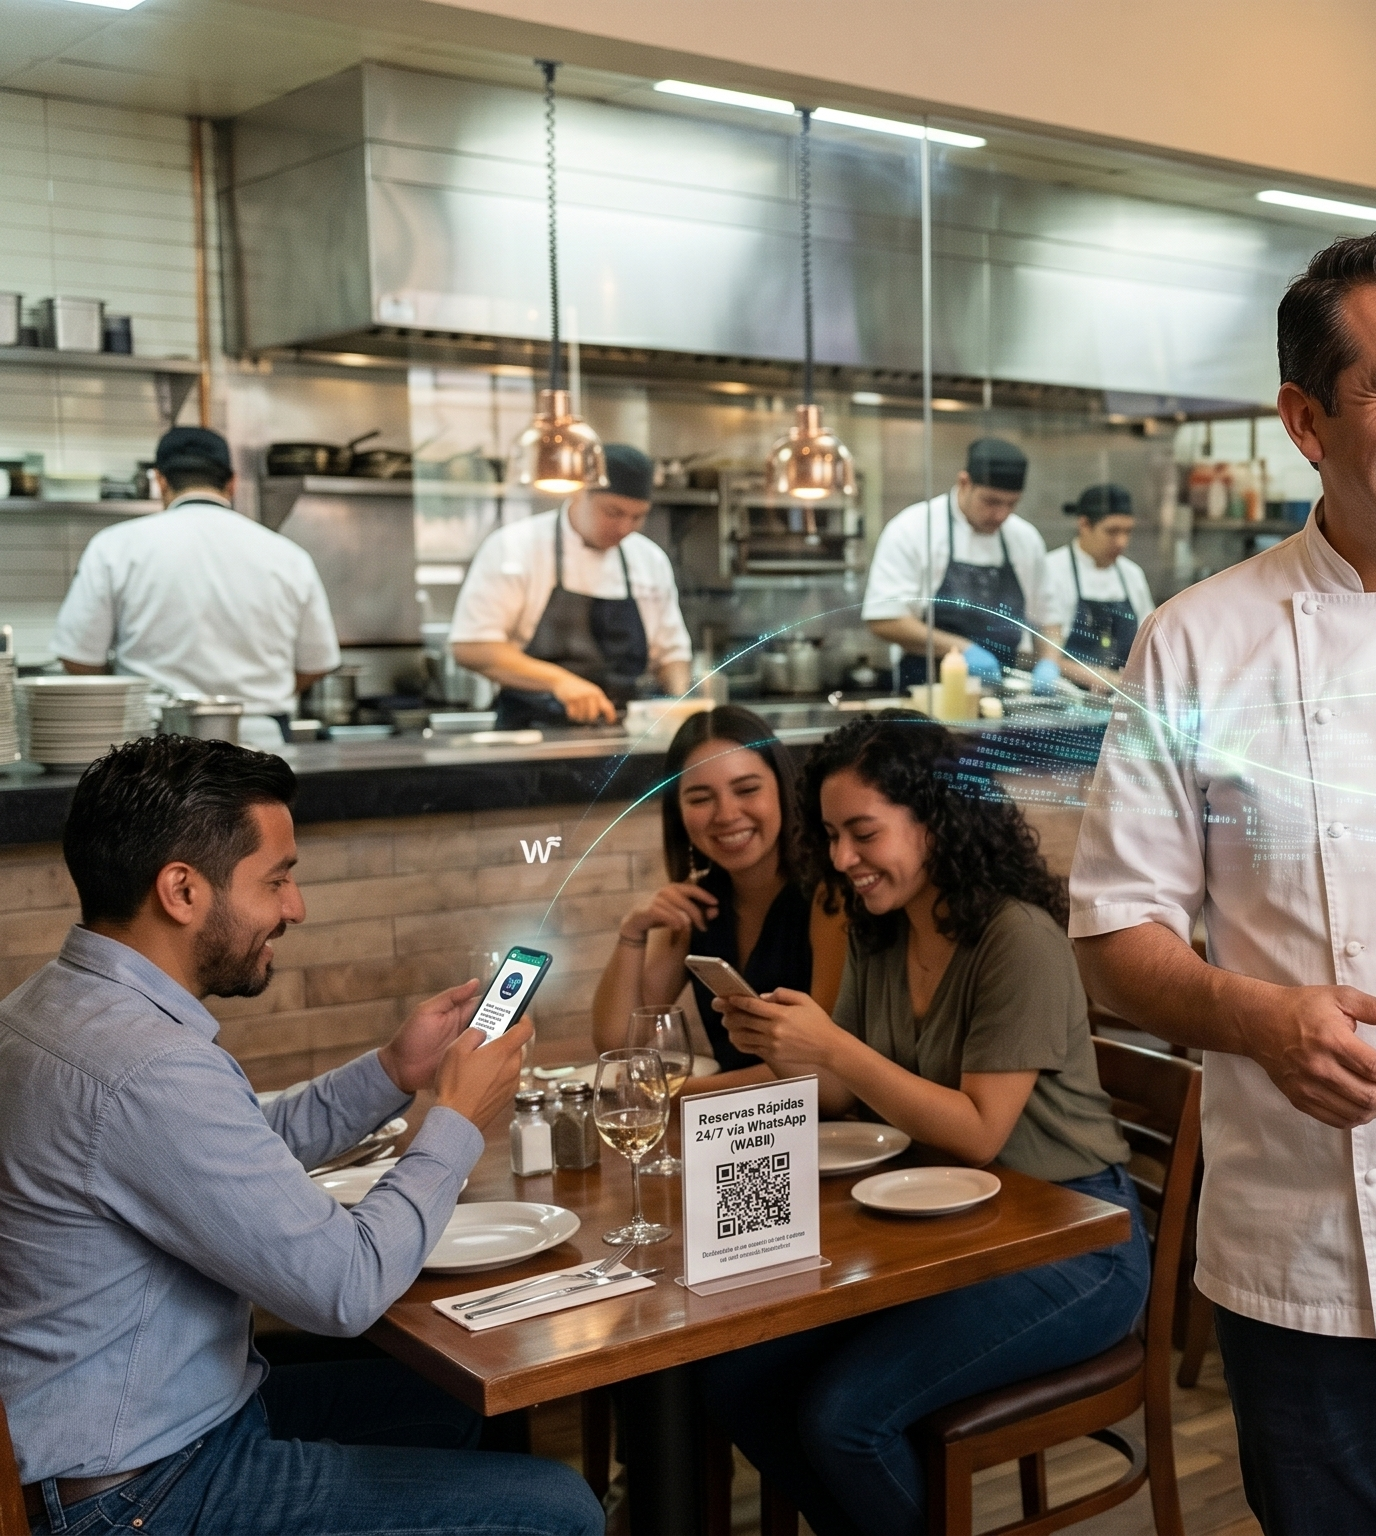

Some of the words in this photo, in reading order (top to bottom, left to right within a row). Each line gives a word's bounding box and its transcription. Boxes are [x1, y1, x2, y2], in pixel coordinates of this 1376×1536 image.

[698, 1107, 755, 1126] Reservas
[757, 1098, 804, 1115] Rápidas
[695, 1127, 724, 1142] 24/7
[727, 1123, 745, 1136] via
[747, 1114, 807, 1133] WhatsApp
[730, 1132, 775, 1154] (WABII)
